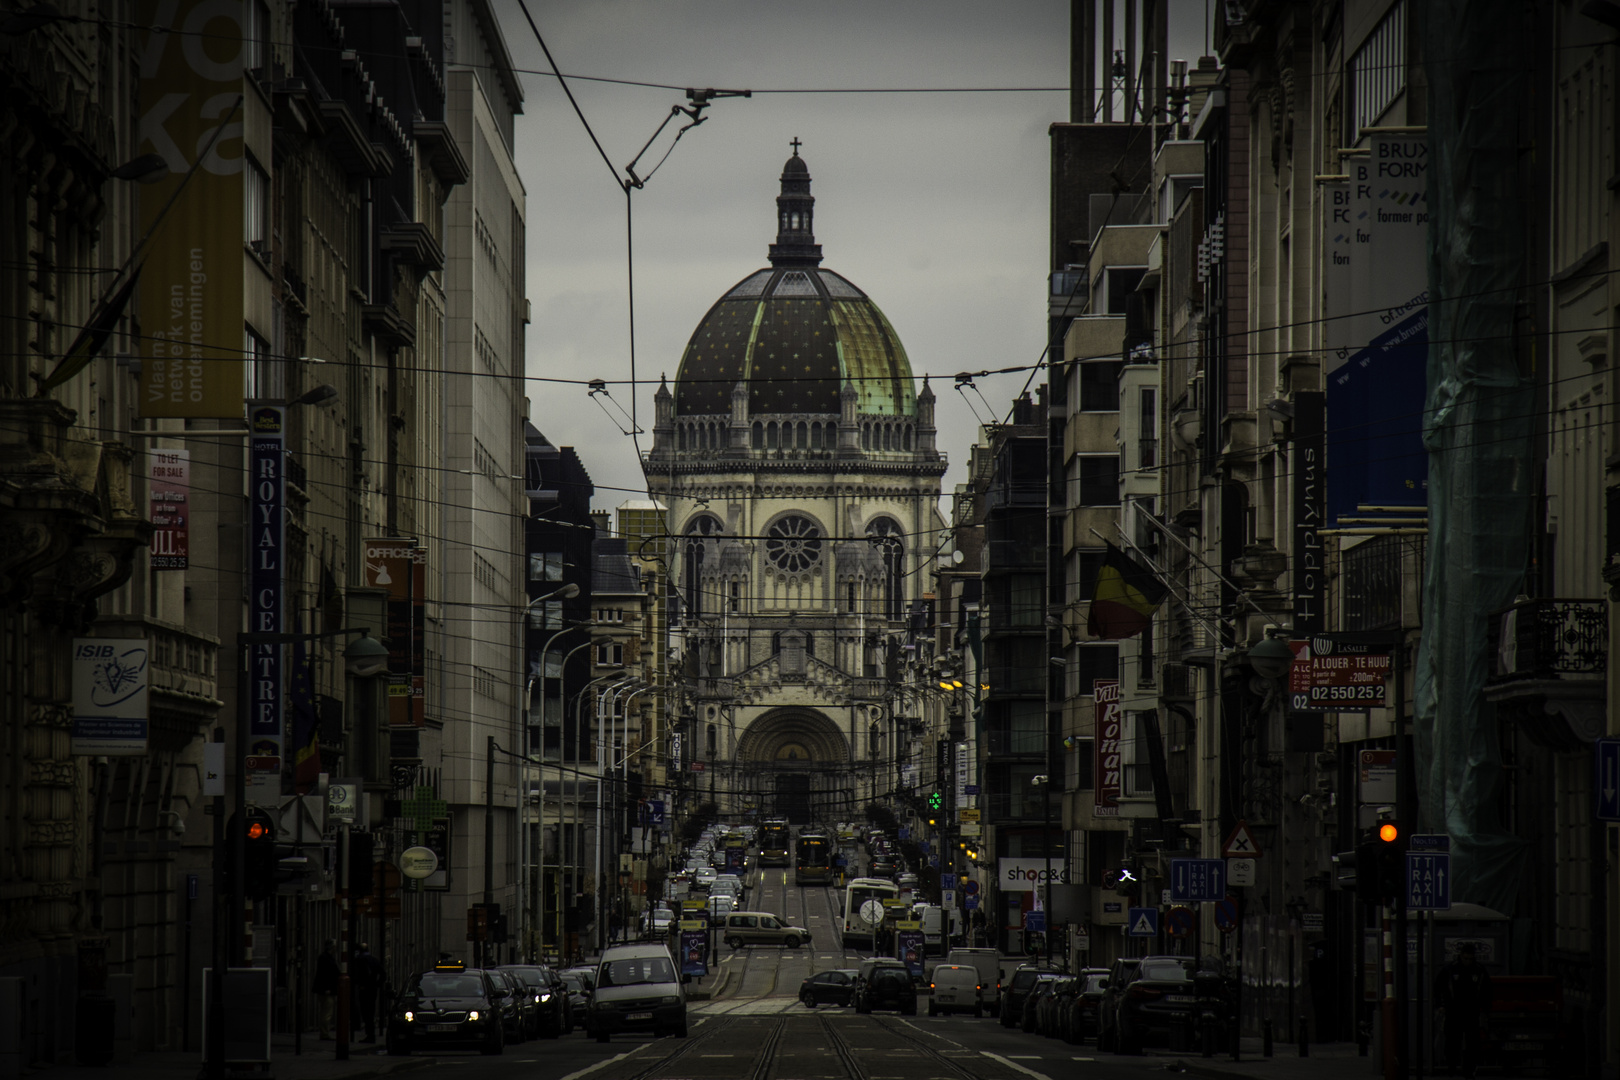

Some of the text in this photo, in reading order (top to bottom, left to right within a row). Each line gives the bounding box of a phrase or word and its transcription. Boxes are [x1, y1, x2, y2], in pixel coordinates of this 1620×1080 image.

[1377, 208, 1413, 223] former
[187, 248, 207, 403] ondernemingen
[167, 284, 184, 403] netwerk van
[149, 330, 165, 403] Vlaams
[158, 454, 179, 464] TO LET
[254, 443, 280, 451] HOTEL
[153, 466, 184, 478] FOR SALE
[258, 458, 277, 570] ROYAL
[151, 529, 177, 556] JLL
[1296, 447, 1321, 622] Hopplynus
[76, 645, 115, 658] ISIB
[257, 588, 276, 724] CENTRE
[1313, 656, 1320, 669] A
[1321, 656, 1349, 669] LOUER
[1355, 656, 1366, 669] TE
[1293, 695, 1308, 710] 02
[1311, 686, 1329, 700] 02
[1330, 685, 1356, 700] 550
[1357, 685, 1375, 699] 25
[673, 734, 681, 771] HOTEL
[1411, 857, 1423, 907] TRAM
[1423, 857, 1433, 907] TAXI
